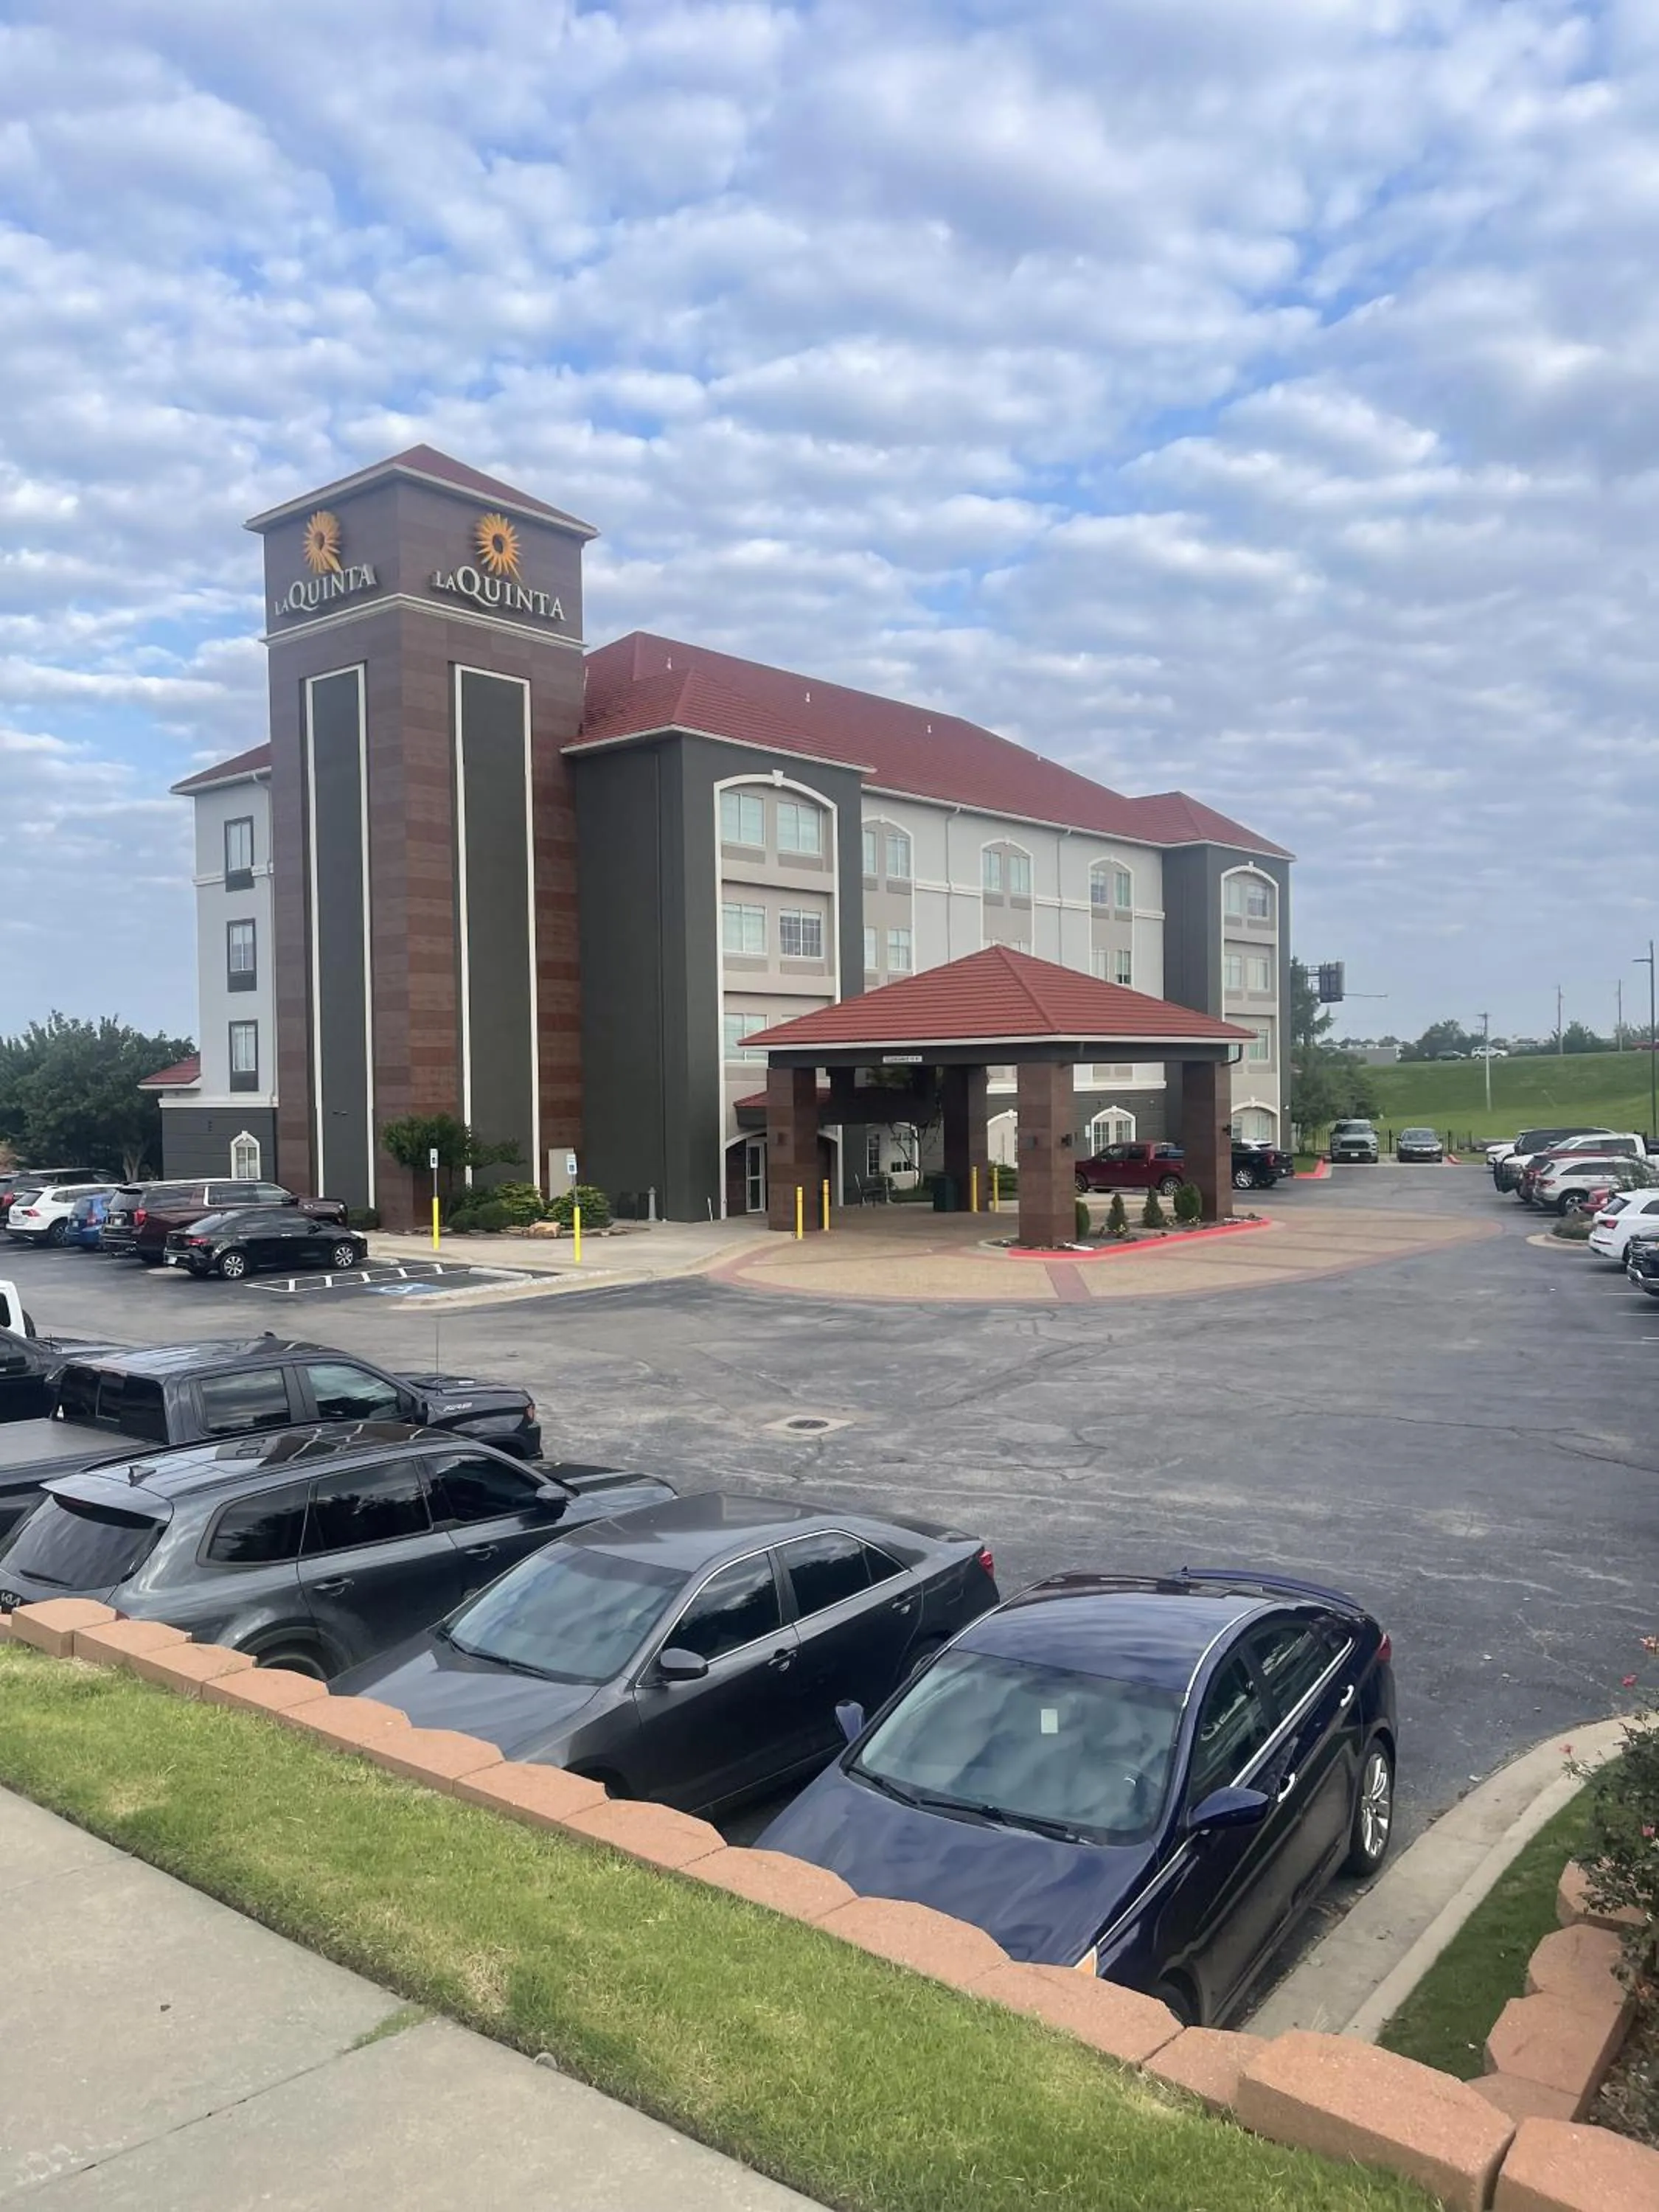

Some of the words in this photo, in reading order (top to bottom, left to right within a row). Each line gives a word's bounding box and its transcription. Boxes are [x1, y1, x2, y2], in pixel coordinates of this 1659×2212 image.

[274, 599, 288, 616] LA
[288, 563, 377, 611] QUINTA
[434, 570, 457, 591] LA
[456, 566, 566, 621] QUINTA
